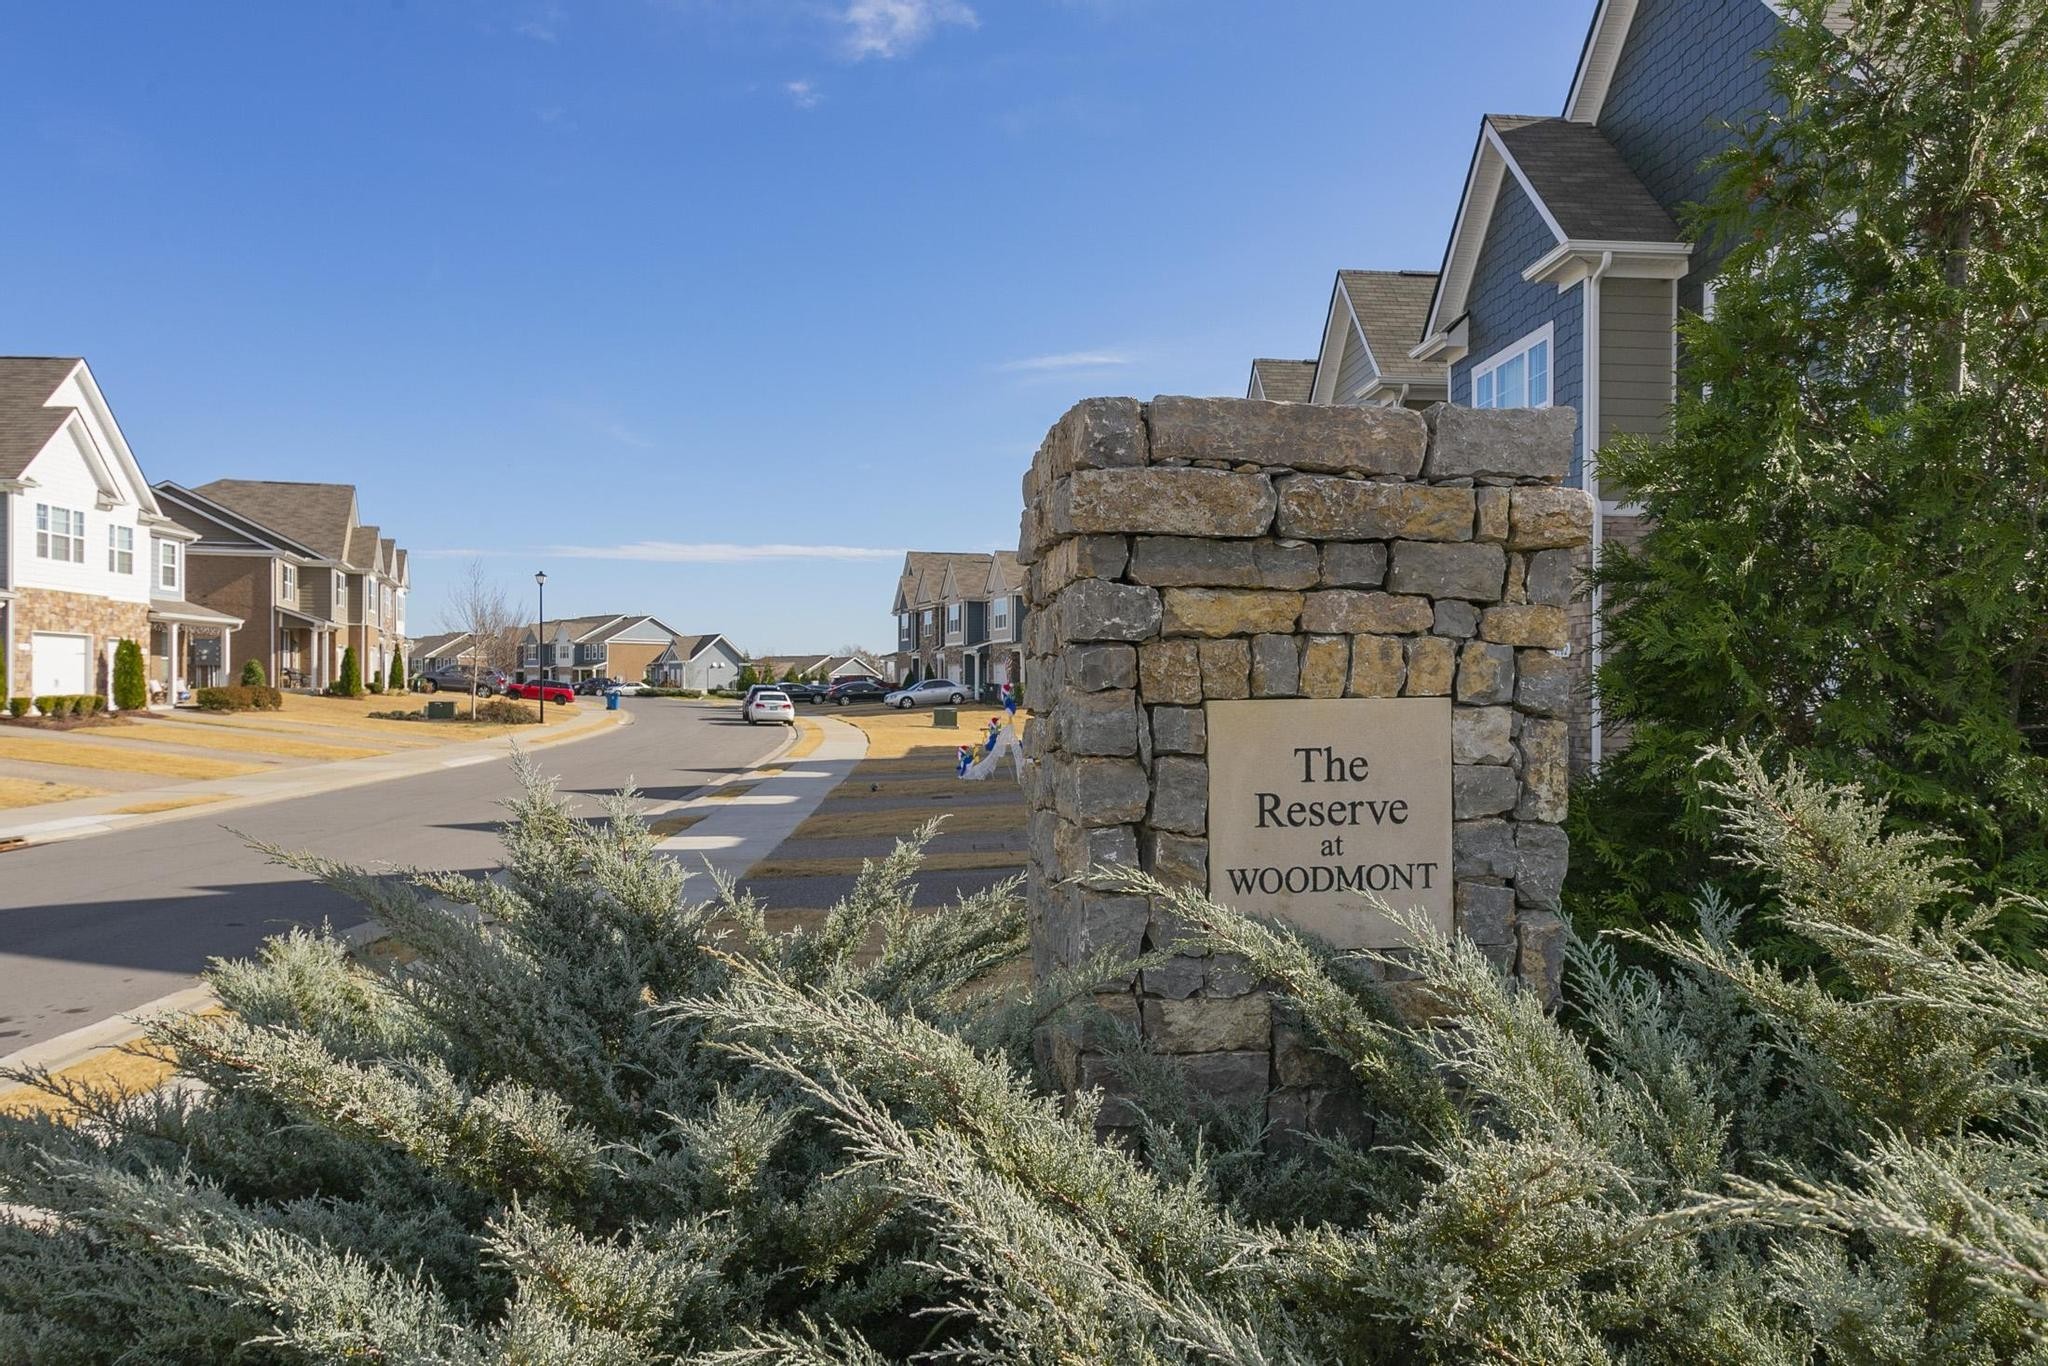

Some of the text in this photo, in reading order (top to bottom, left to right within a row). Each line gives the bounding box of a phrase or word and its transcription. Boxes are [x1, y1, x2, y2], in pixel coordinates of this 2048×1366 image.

[1294, 746, 1369, 782] The
[1255, 792, 1408, 828] Reserve
[1320, 835, 1344, 857] at
[1226, 862, 1438, 895] WOODMONT
